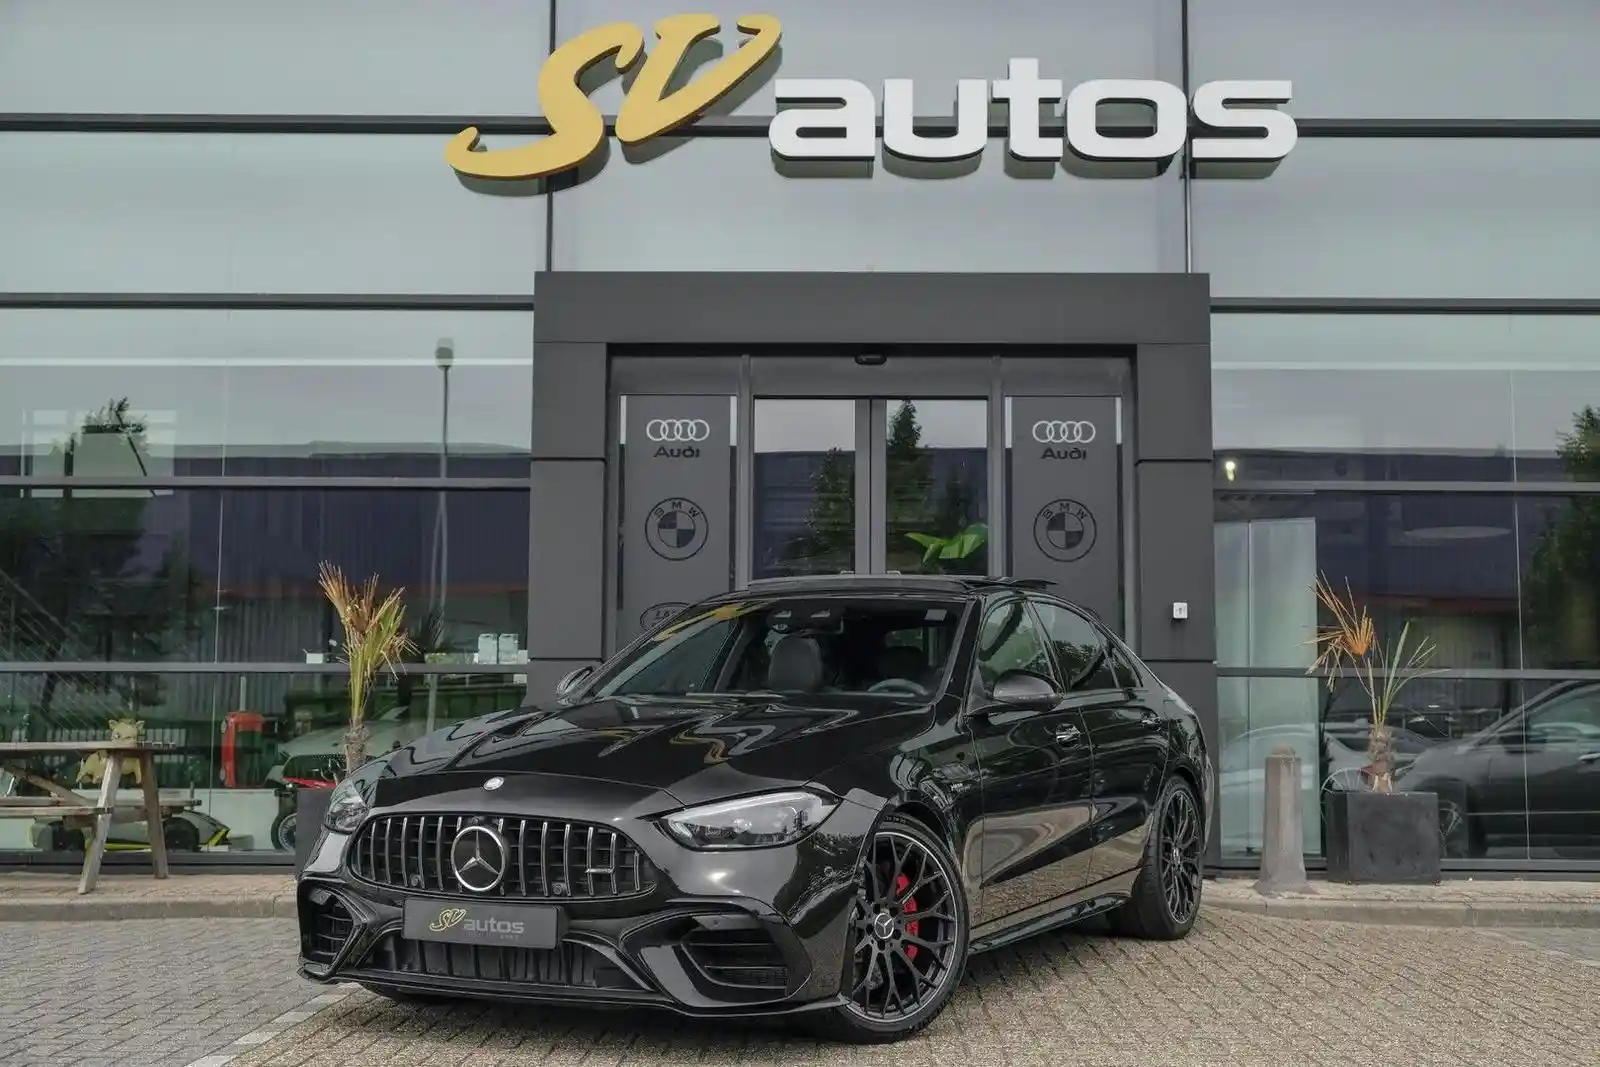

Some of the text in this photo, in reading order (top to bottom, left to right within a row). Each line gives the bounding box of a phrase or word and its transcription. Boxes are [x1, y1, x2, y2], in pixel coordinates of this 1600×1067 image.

[444, 13, 1299, 180] SV autos
[653, 445, 700, 459] Audi
[1041, 446, 1087, 460] Audi
[463, 917, 525, 934] autos
